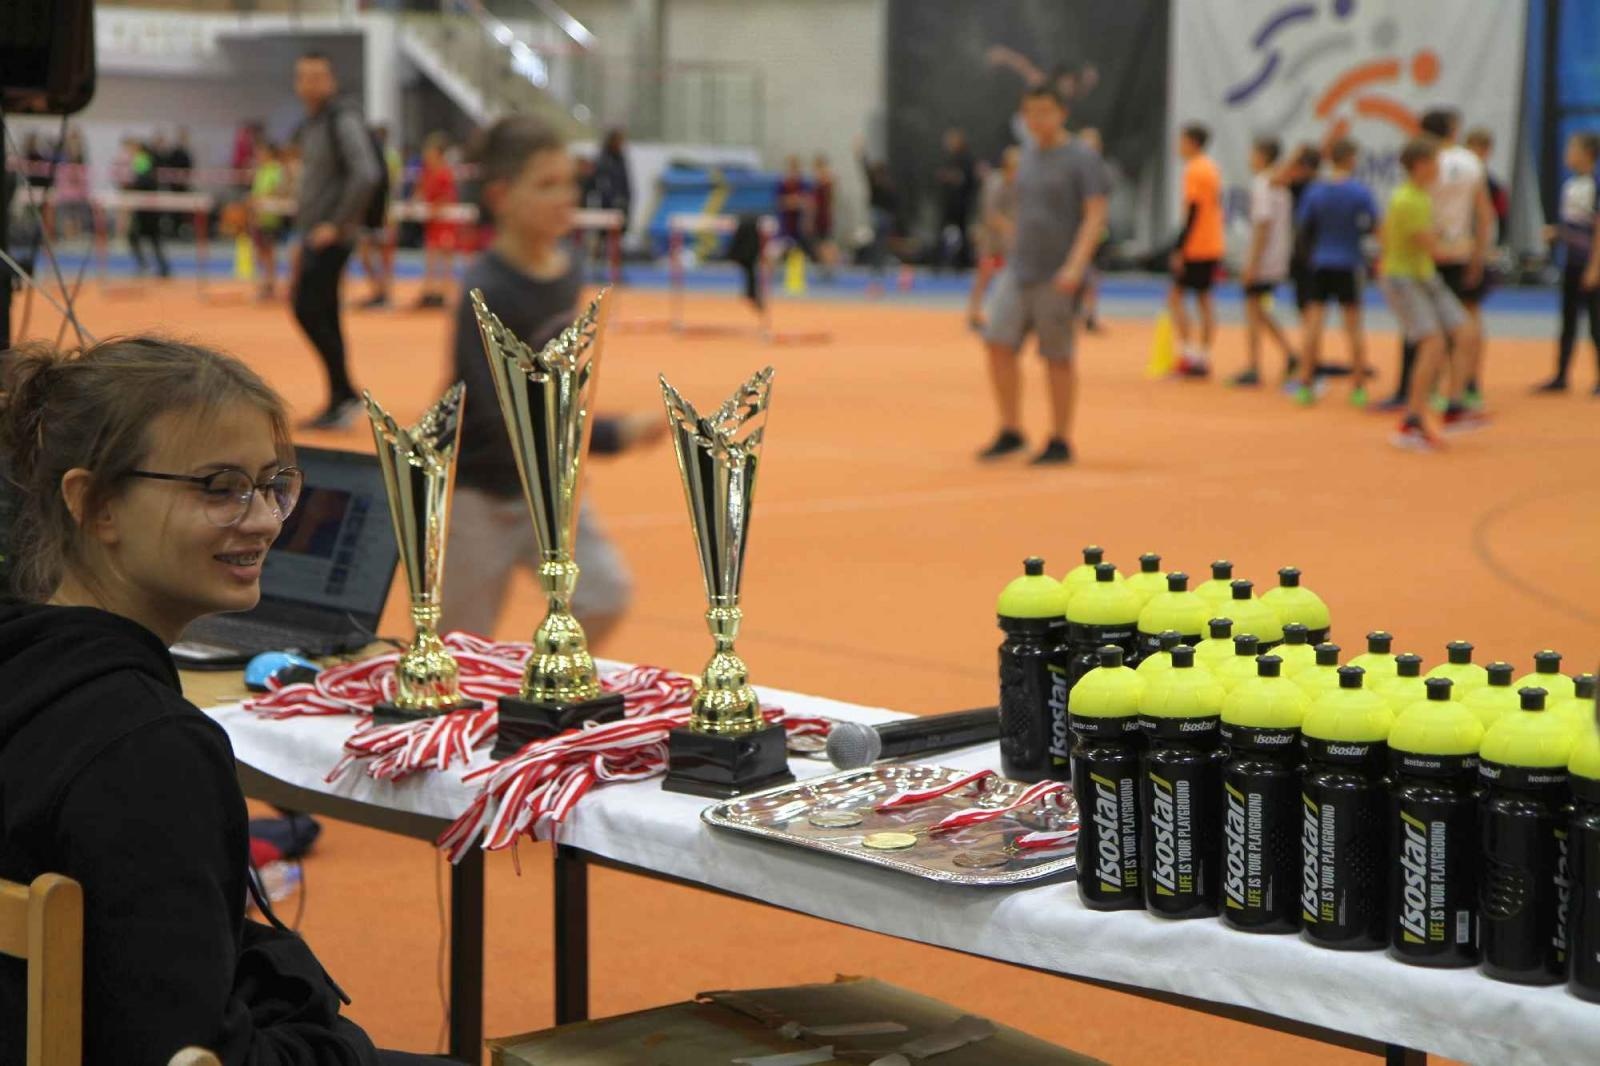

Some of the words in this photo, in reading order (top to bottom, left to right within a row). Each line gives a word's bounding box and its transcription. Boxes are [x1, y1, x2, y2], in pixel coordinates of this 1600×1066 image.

[1182, 720, 1215, 732] isostar
[1256, 734, 1293, 745] isostar
[1329, 744, 1366, 756] isostar
[1119, 778, 1136, 834] PLAYGROUND
[1175, 780, 1191, 837] PLAYGROUND
[1248, 793, 1262, 853] PLAYGROUND
[1321, 804, 1336, 864] PLAYGROUND
[1093, 782, 1122, 888] isostar
[1122, 834, 1137, 859] YOUR
[1151, 782, 1176, 891] isostar
[1178, 839, 1192, 862] YOUR
[1224, 792, 1245, 904] isostar
[1430, 821, 1446, 882] PLAYGROUND
[1123, 859, 1137, 869] IS
[1178, 863, 1192, 873] IS
[1248, 854, 1262, 878] YOUR
[1301, 803, 1319, 917] isostar
[1124, 869, 1138, 888] LIFE
[1179, 874, 1193, 893] LIFE
[1248, 878, 1262, 888] IS
[1321, 865, 1335, 891] YOUR
[1399, 822, 1427, 938] isostar
[1247, 888, 1261, 908] LIFE
[1321, 891, 1335, 901] IS
[1430, 883, 1446, 910] YOUR
[1321, 901, 1335, 922] LIFE
[1430, 910, 1445, 920] IS
[1429, 921, 1445, 941] LIFE
